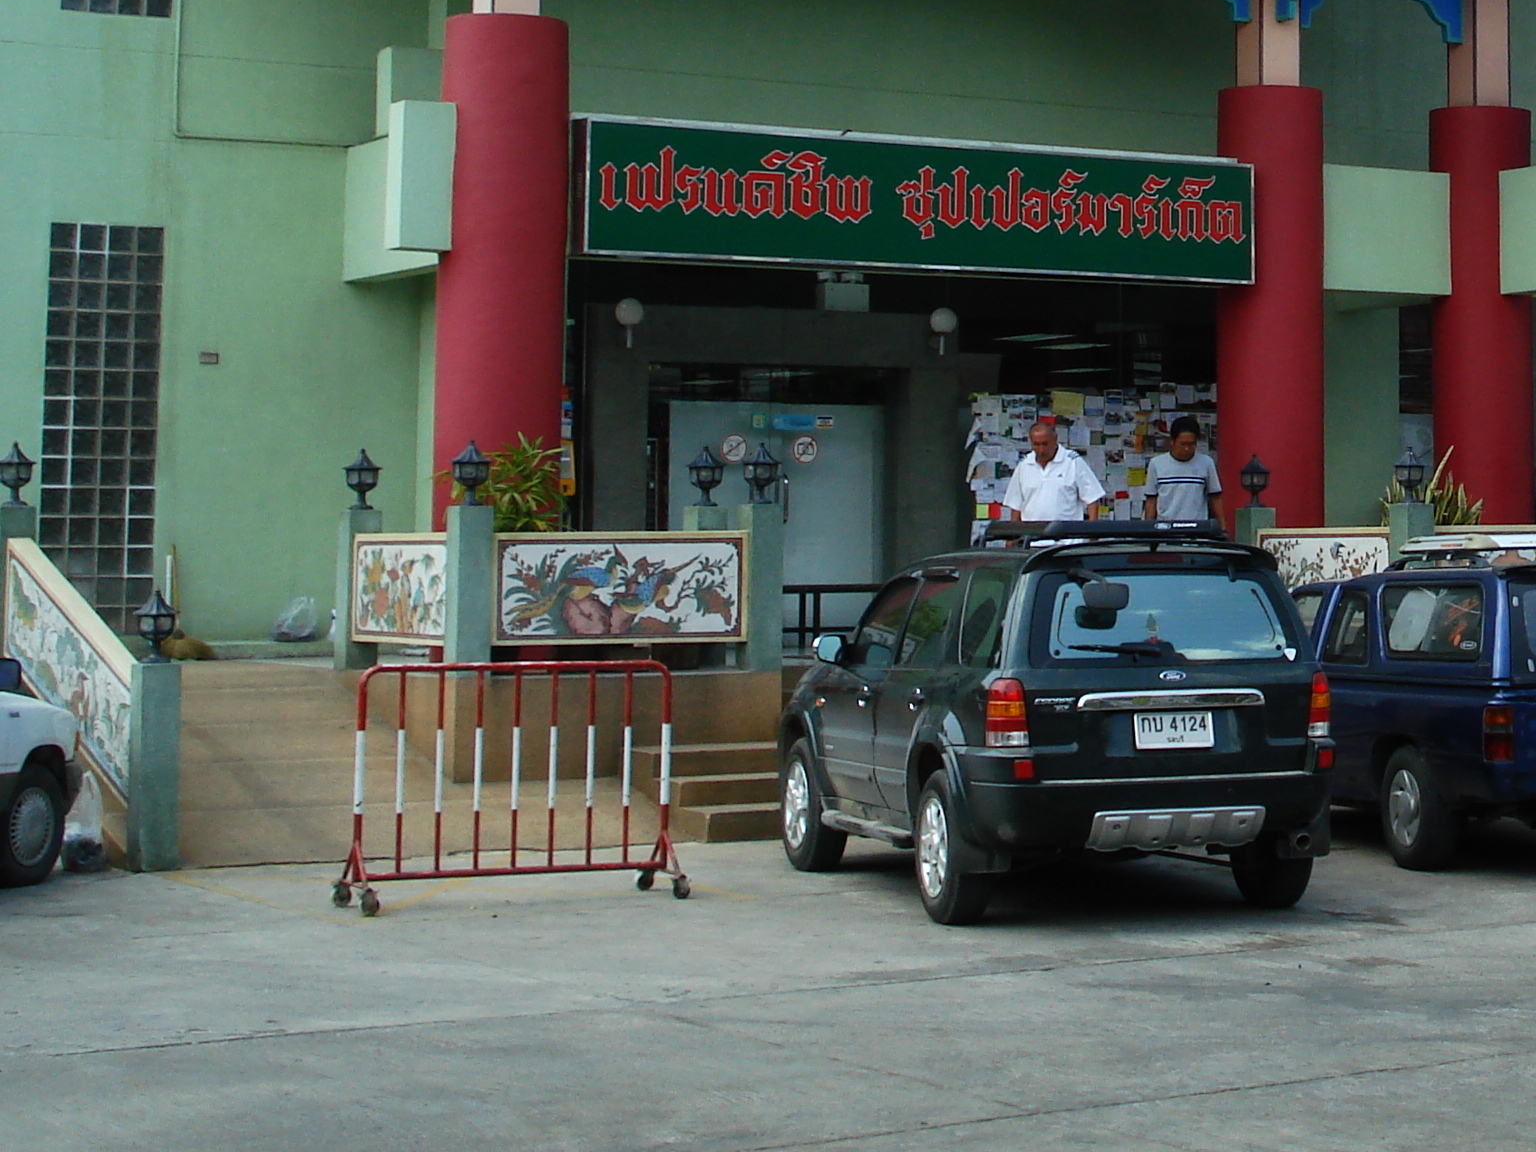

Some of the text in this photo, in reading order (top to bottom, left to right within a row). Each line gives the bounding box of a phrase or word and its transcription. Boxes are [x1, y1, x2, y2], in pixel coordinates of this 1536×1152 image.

[598, 144, 1247, 245] เฟรนด์ชิพ ซุปเปอร์มาร์เก็ต
[1169, 715, 1208, 733] 4124
